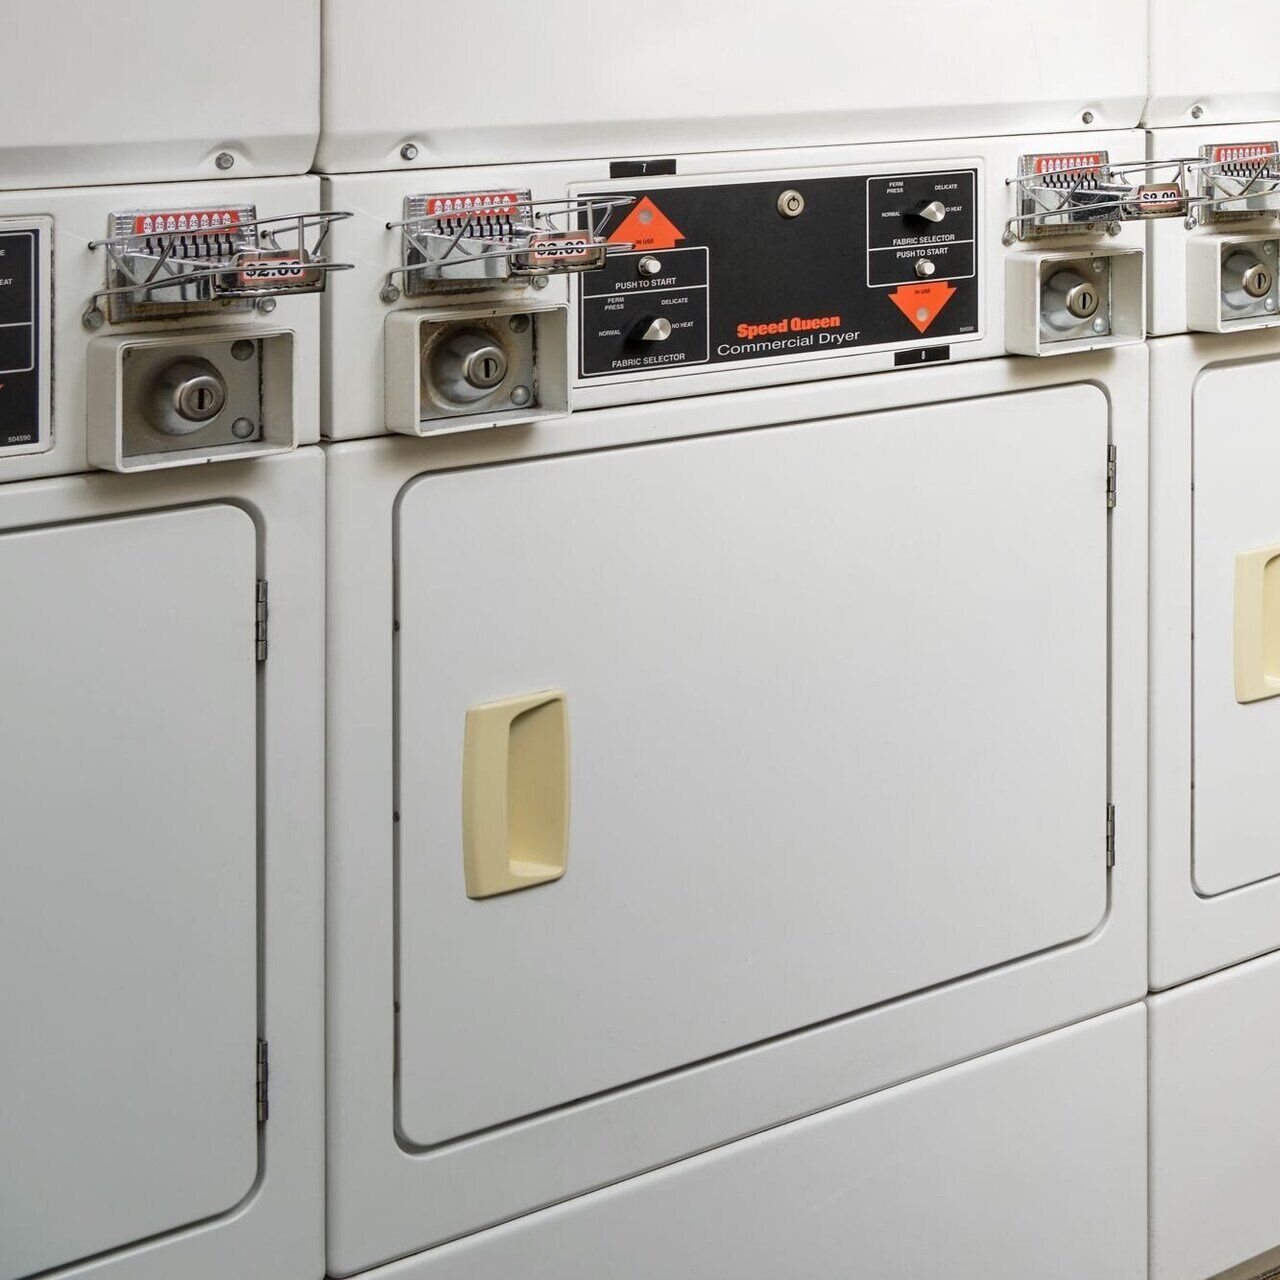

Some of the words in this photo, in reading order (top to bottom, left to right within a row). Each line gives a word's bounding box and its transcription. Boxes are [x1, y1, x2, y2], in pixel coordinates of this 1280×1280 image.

[642, 164, 647, 173] 7
[1143, 192, 1176, 203] $200
[892, 237, 918, 246] FABRIC
[919, 234, 955, 243] SELECTOR
[536, 241, 585, 256] $2.00
[896, 250, 916, 258] PUSH
[927, 247, 949, 255] START
[246, 261, 301, 278] $2.00
[615, 281, 637, 290] PUSH
[638, 280, 650, 288] TO
[651, 277, 676, 286] START
[661, 297, 688, 305] DELICATE
[599, 329, 621, 337] NORMAL
[736, 319, 788, 339] Speed
[790, 315, 841, 332] Queen
[717, 335, 813, 356] Commercial
[818, 331, 861, 345] Dryer
[611, 358, 641, 368] FABRIC
[643, 353, 686, 364] SELECTOR
